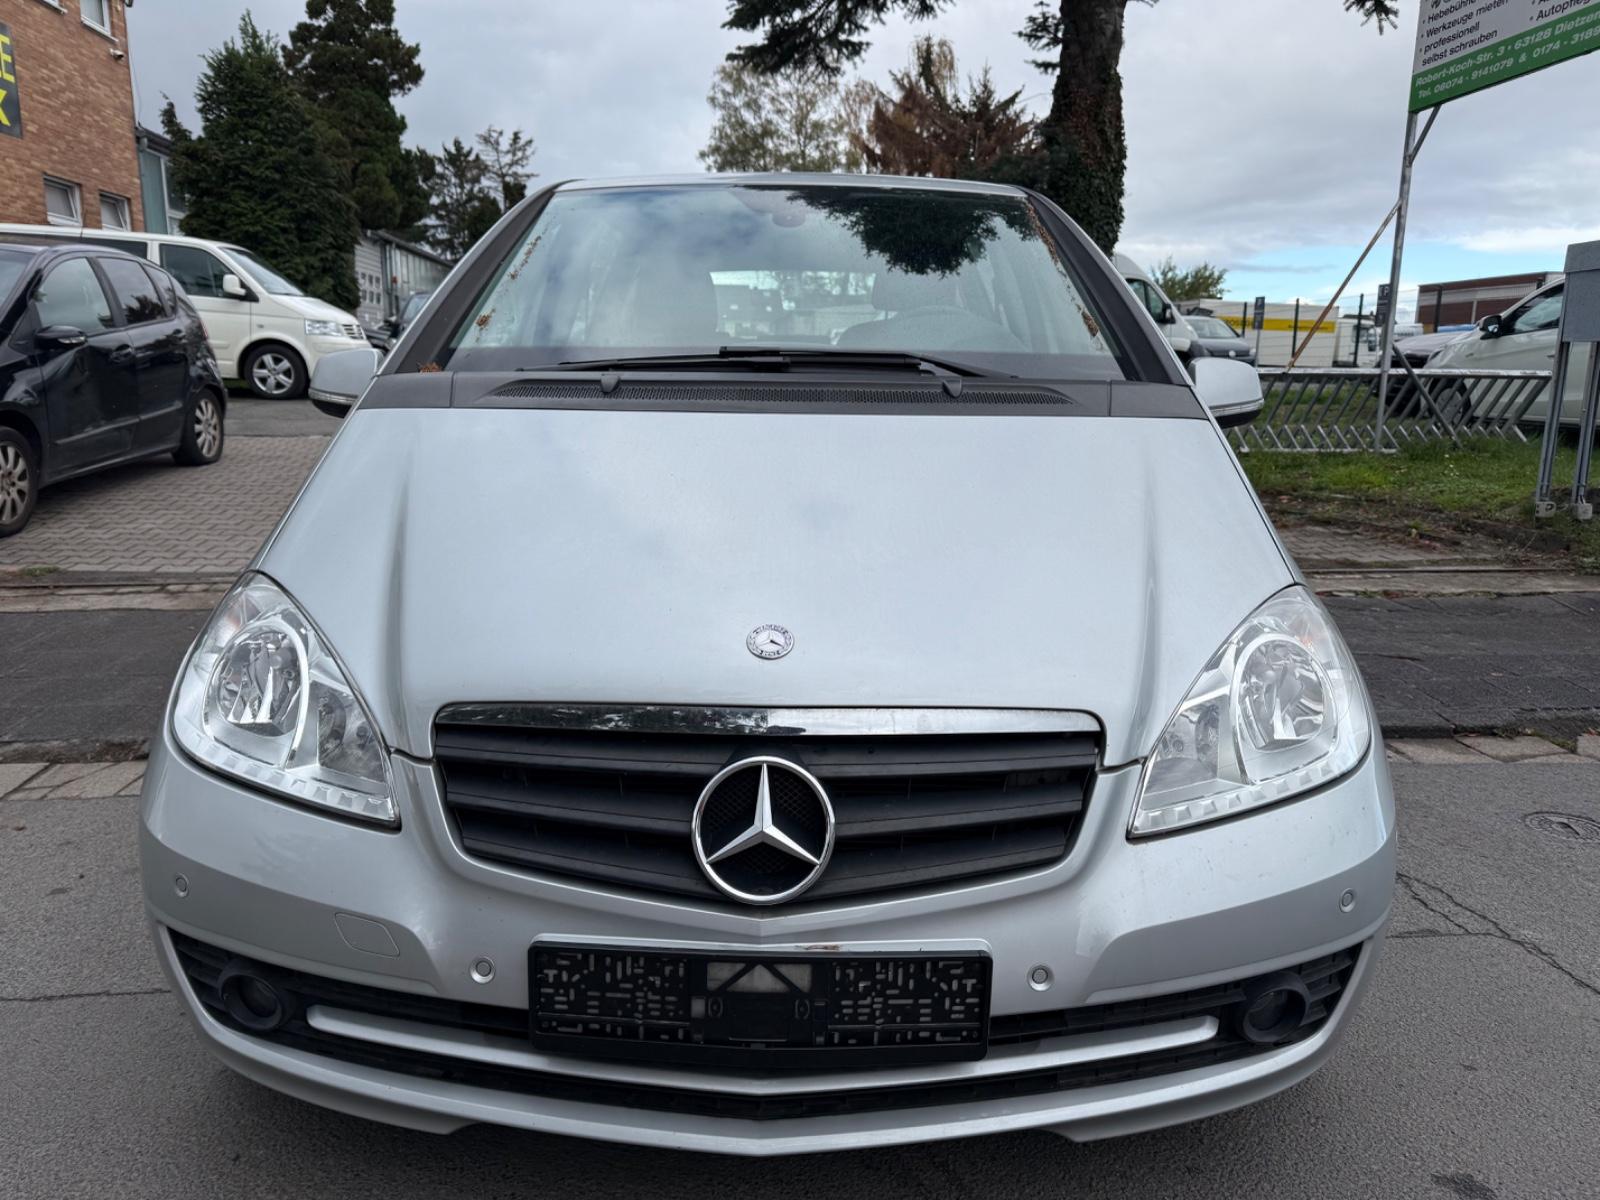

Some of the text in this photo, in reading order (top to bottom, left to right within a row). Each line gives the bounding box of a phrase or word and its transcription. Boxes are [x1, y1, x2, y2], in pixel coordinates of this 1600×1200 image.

[1424, 21, 1480, 55] professionell
[1426, 11, 1474, 38] Werkzeuge
[1415, 51, 1493, 86] Robert-Koch-Str.
[1497, 46, 1505, 57] 3
[1514, 28, 1552, 49] 63128
[1422, 30, 1498, 66] selbst schrauben
[1533, 40, 1560, 57] 0174
